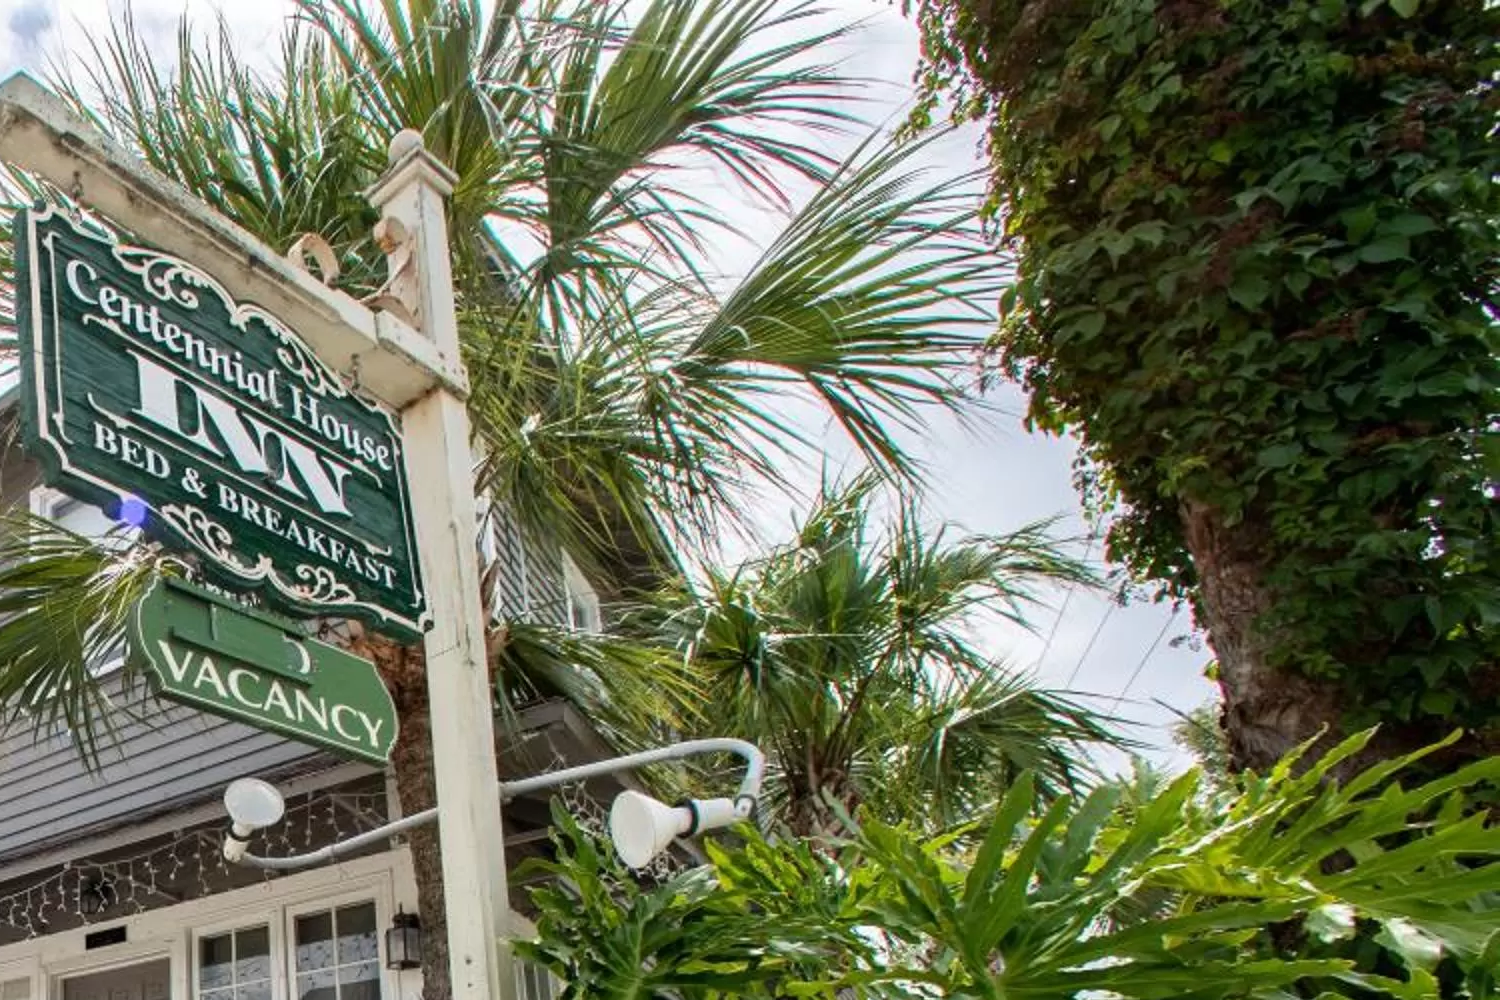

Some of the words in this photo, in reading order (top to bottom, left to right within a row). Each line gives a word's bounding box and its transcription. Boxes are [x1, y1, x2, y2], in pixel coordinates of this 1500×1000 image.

[65, 258, 281, 409] Centennial
[288, 384, 394, 473] House
[126, 348, 354, 518] INN
[93, 421, 172, 480] BED
[181, 466, 209, 500] &
[218, 482, 398, 590] BREAKFAST
[156, 639, 384, 748] VACANCY
